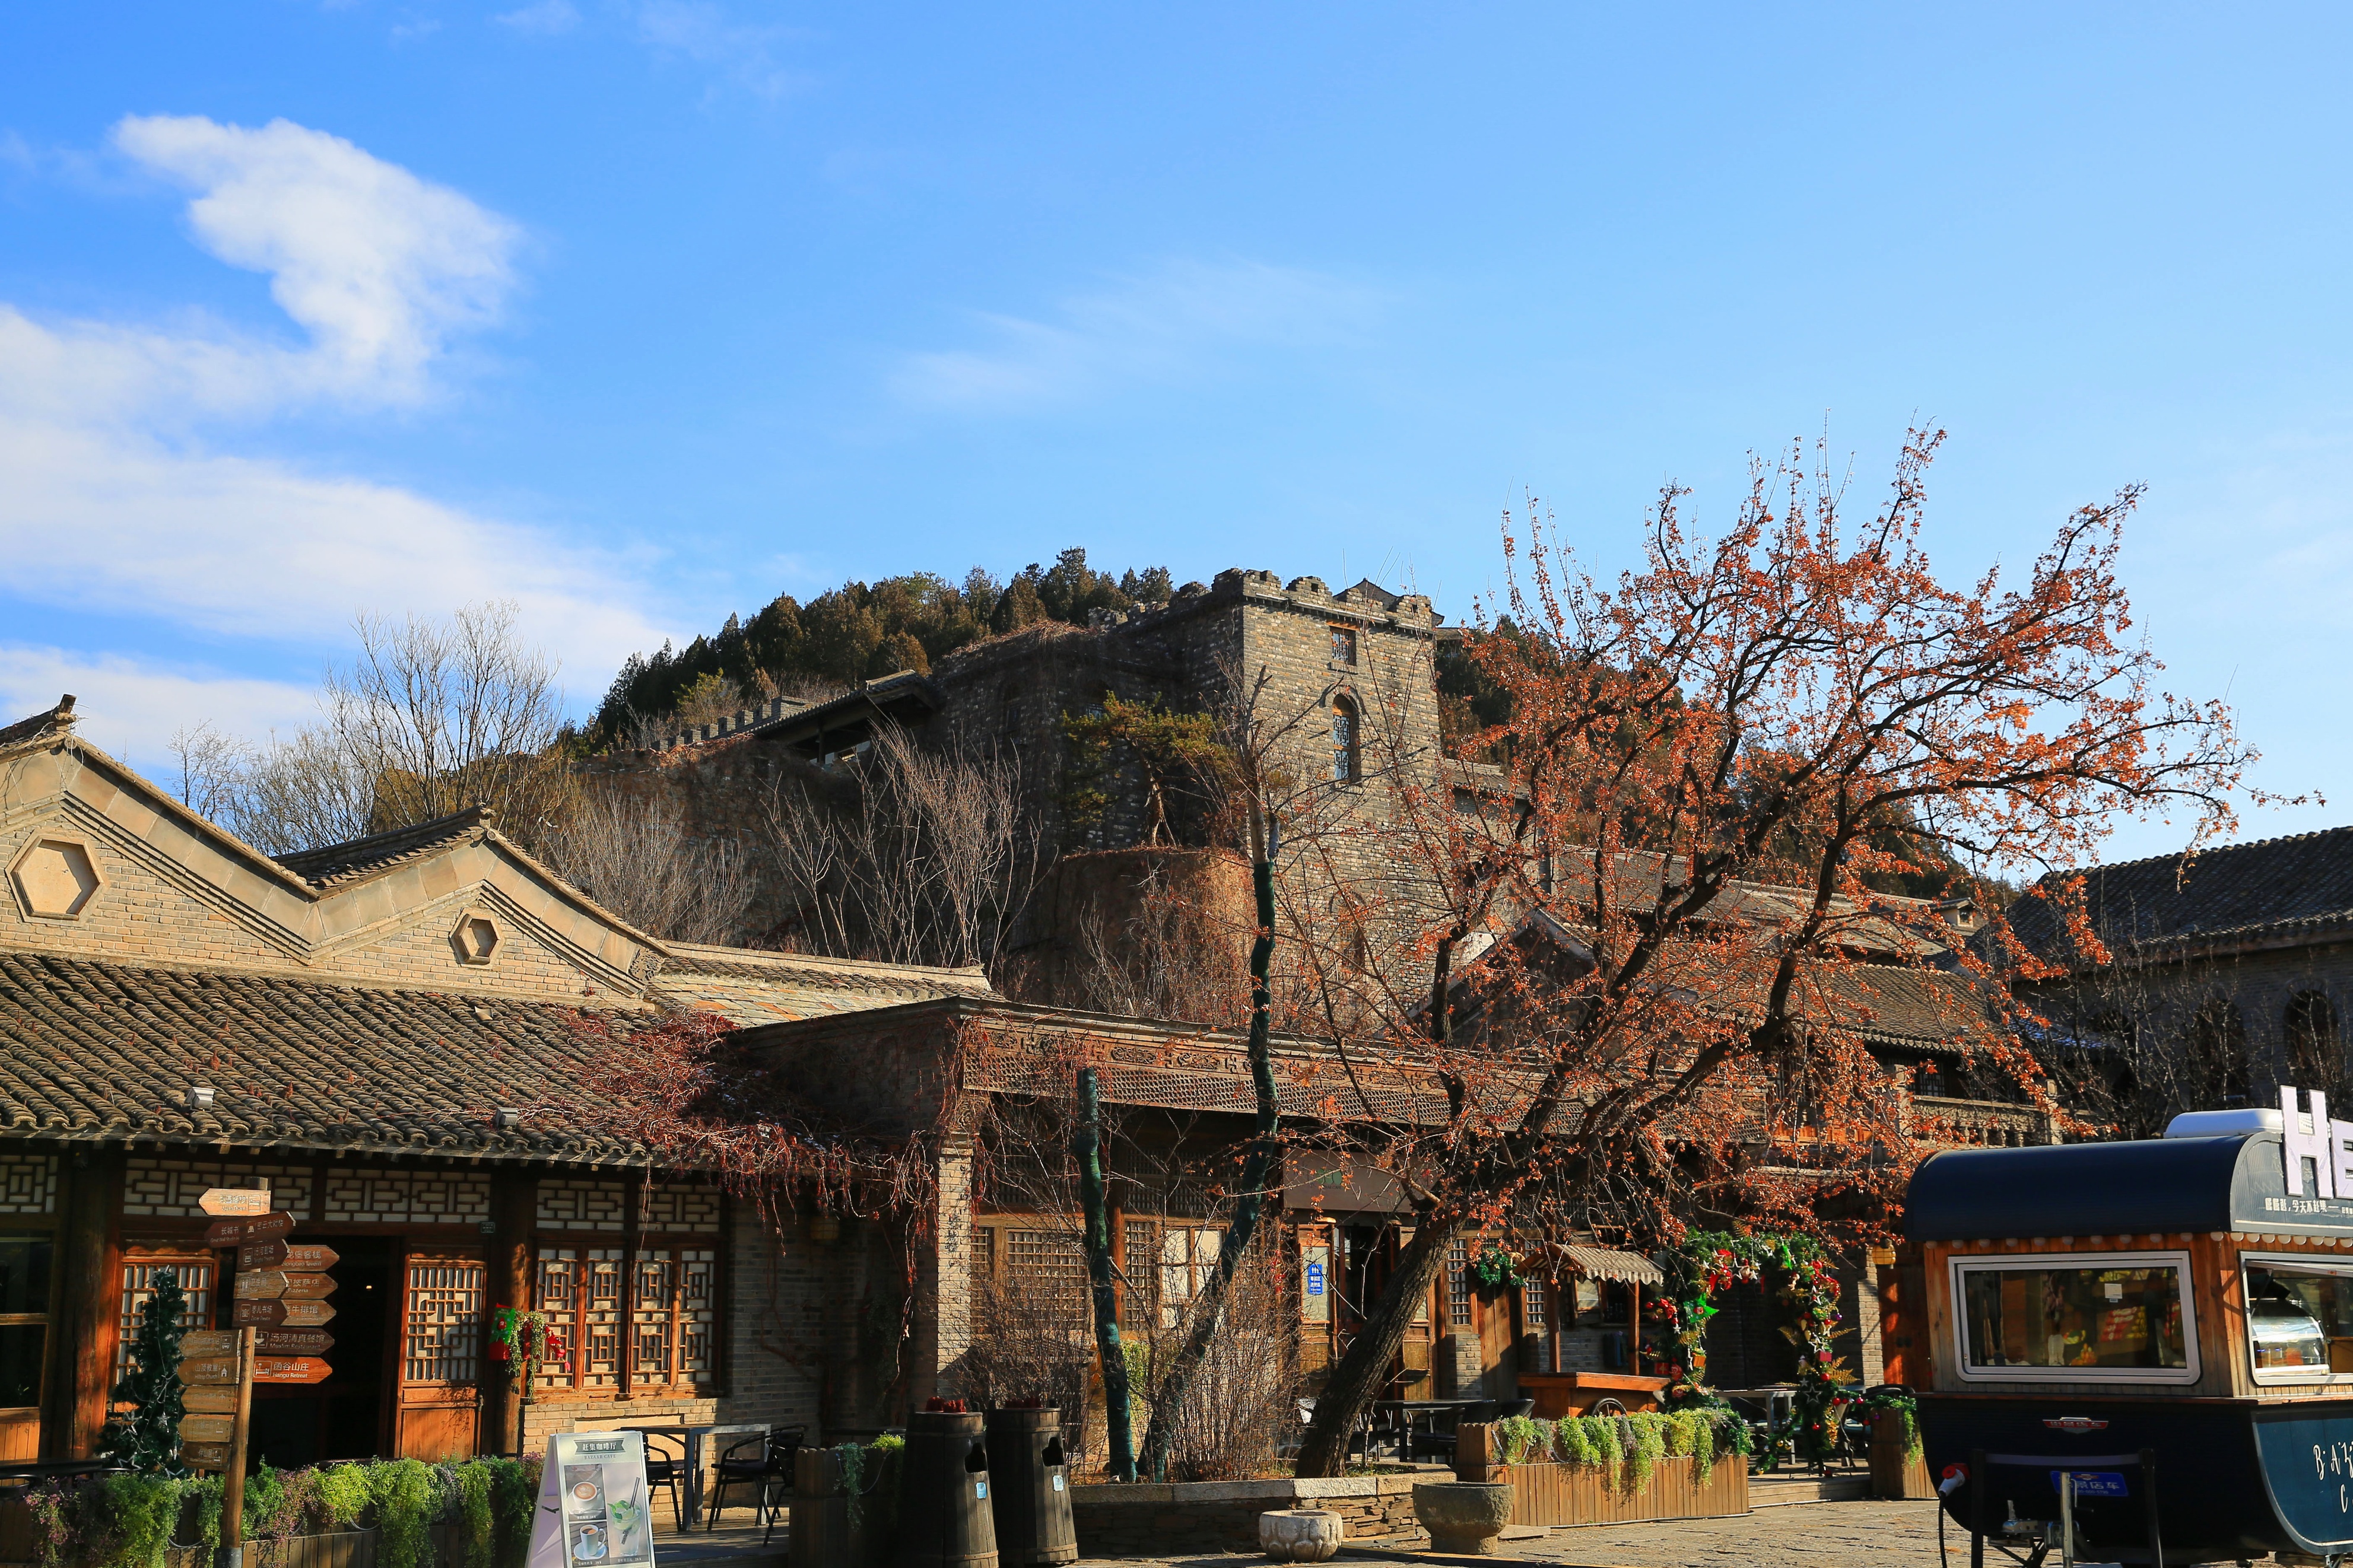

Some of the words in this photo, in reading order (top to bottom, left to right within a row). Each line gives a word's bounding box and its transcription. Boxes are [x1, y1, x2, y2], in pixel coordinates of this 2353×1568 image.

[250, 1278, 266, 1286] 卫生间
[270, 1332, 325, 1343] 汤河清真餐馆
[195, 1363, 218, 1372] 山顶教堂
[274, 1362, 309, 1371] 函谷山庄
[582, 1442, 617, 1451] 赶集咖啡厅
